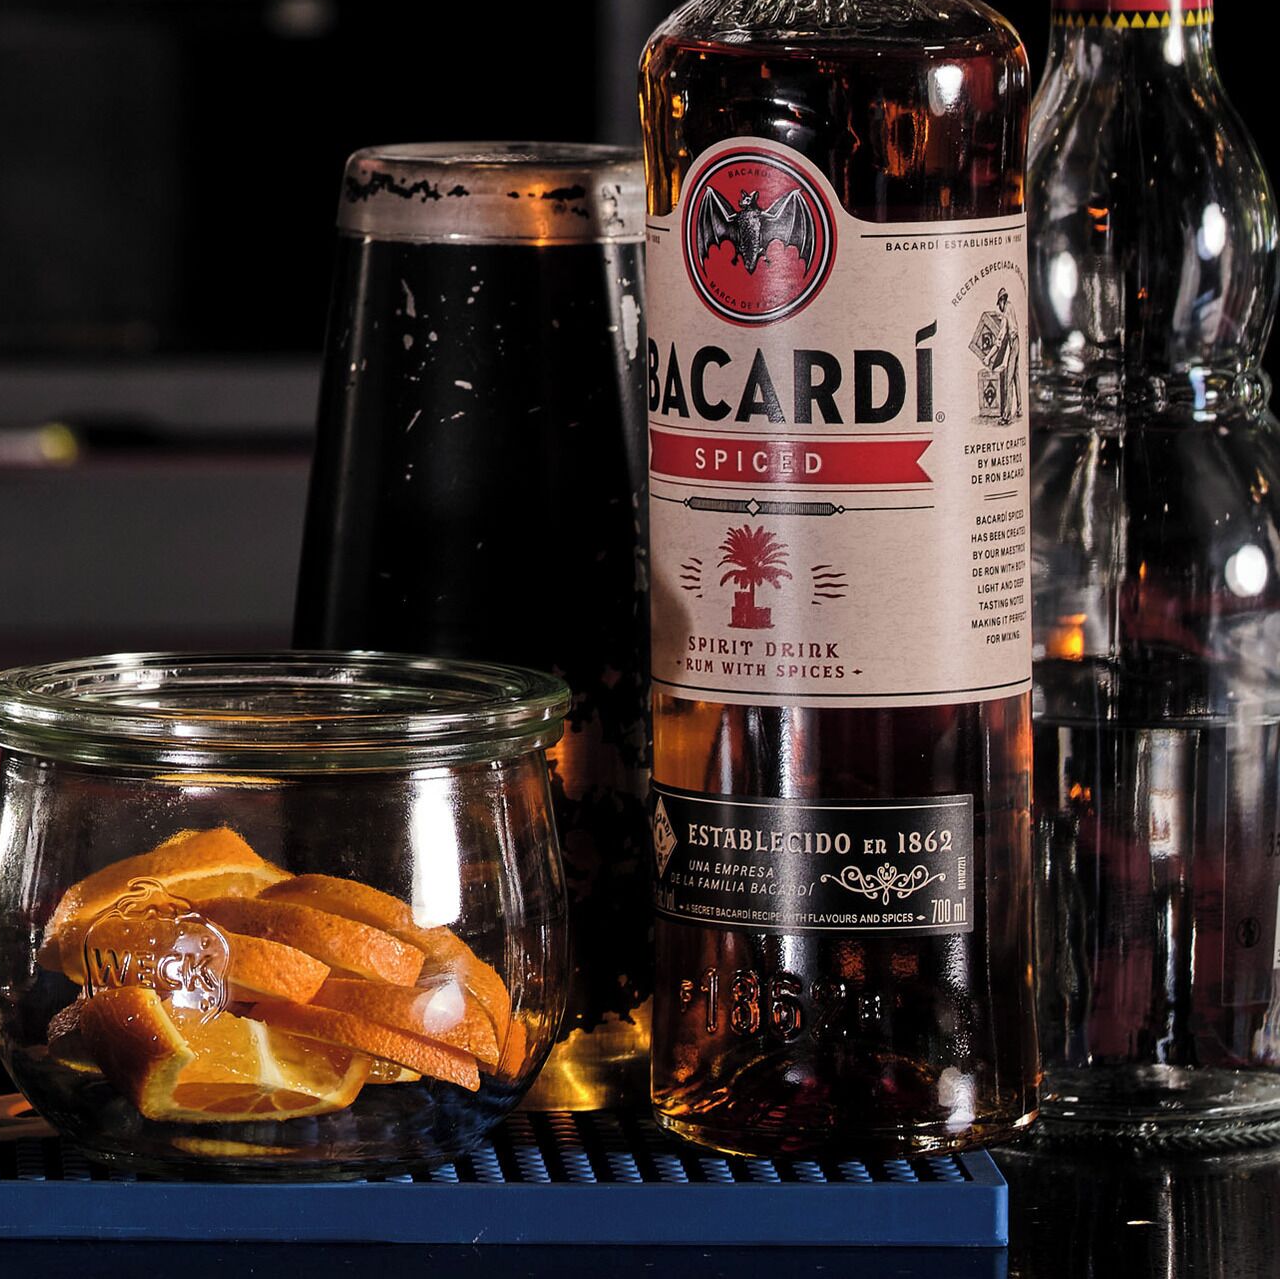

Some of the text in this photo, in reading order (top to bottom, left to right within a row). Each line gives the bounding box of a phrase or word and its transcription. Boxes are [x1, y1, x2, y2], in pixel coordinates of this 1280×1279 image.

[885, 240, 939, 252] BACARDÍ
[944, 237, 1003, 250] ESTABLISHED
[951, 275, 980, 308] RECETA
[648, 320, 938, 424] BACARDÍ
[964, 441, 1005, 455] EXPERTLY
[695, 447, 823, 475] SPICED
[977, 459, 989, 469] BY
[971, 474, 983, 485] DE
[985, 472, 1001, 484] RON
[971, 532, 988, 543] HAS
[989, 530, 1006, 542] BEEN
[972, 550, 984, 561] BY
[984, 548, 1000, 559] OUR
[972, 567, 983, 578] DE
[984, 565, 1000, 576] RON
[977, 582, 999, 594] LIGHT
[1000, 579, 1013, 591] AND
[979, 598, 1009, 611] TASTING
[971, 616, 1001, 629] MAKING
[1001, 615, 1008, 625] IT
[688, 636, 840, 659] SPIRIT DRINK
[986, 633, 1000, 645] FOR
[686, 658, 845, 679] RUM WITH SPICES
[688, 823, 852, 854] ESTABLECIDO
[897, 829, 953, 854] 1862
[689, 859, 775, 879] UNA EMPRESA
[670, 872, 817, 897] DE LA FAMILIA BACARDÍ
[691, 903, 715, 916] SECRET
[752, 910, 781, 922] RECIPE
[808, 913, 858, 924] FLAVOURS
[859, 913, 880, 924] AND
[882, 913, 914, 924] SPICES
[931, 897, 966, 924] 700 ml
[90, 946, 218, 992] WECK
